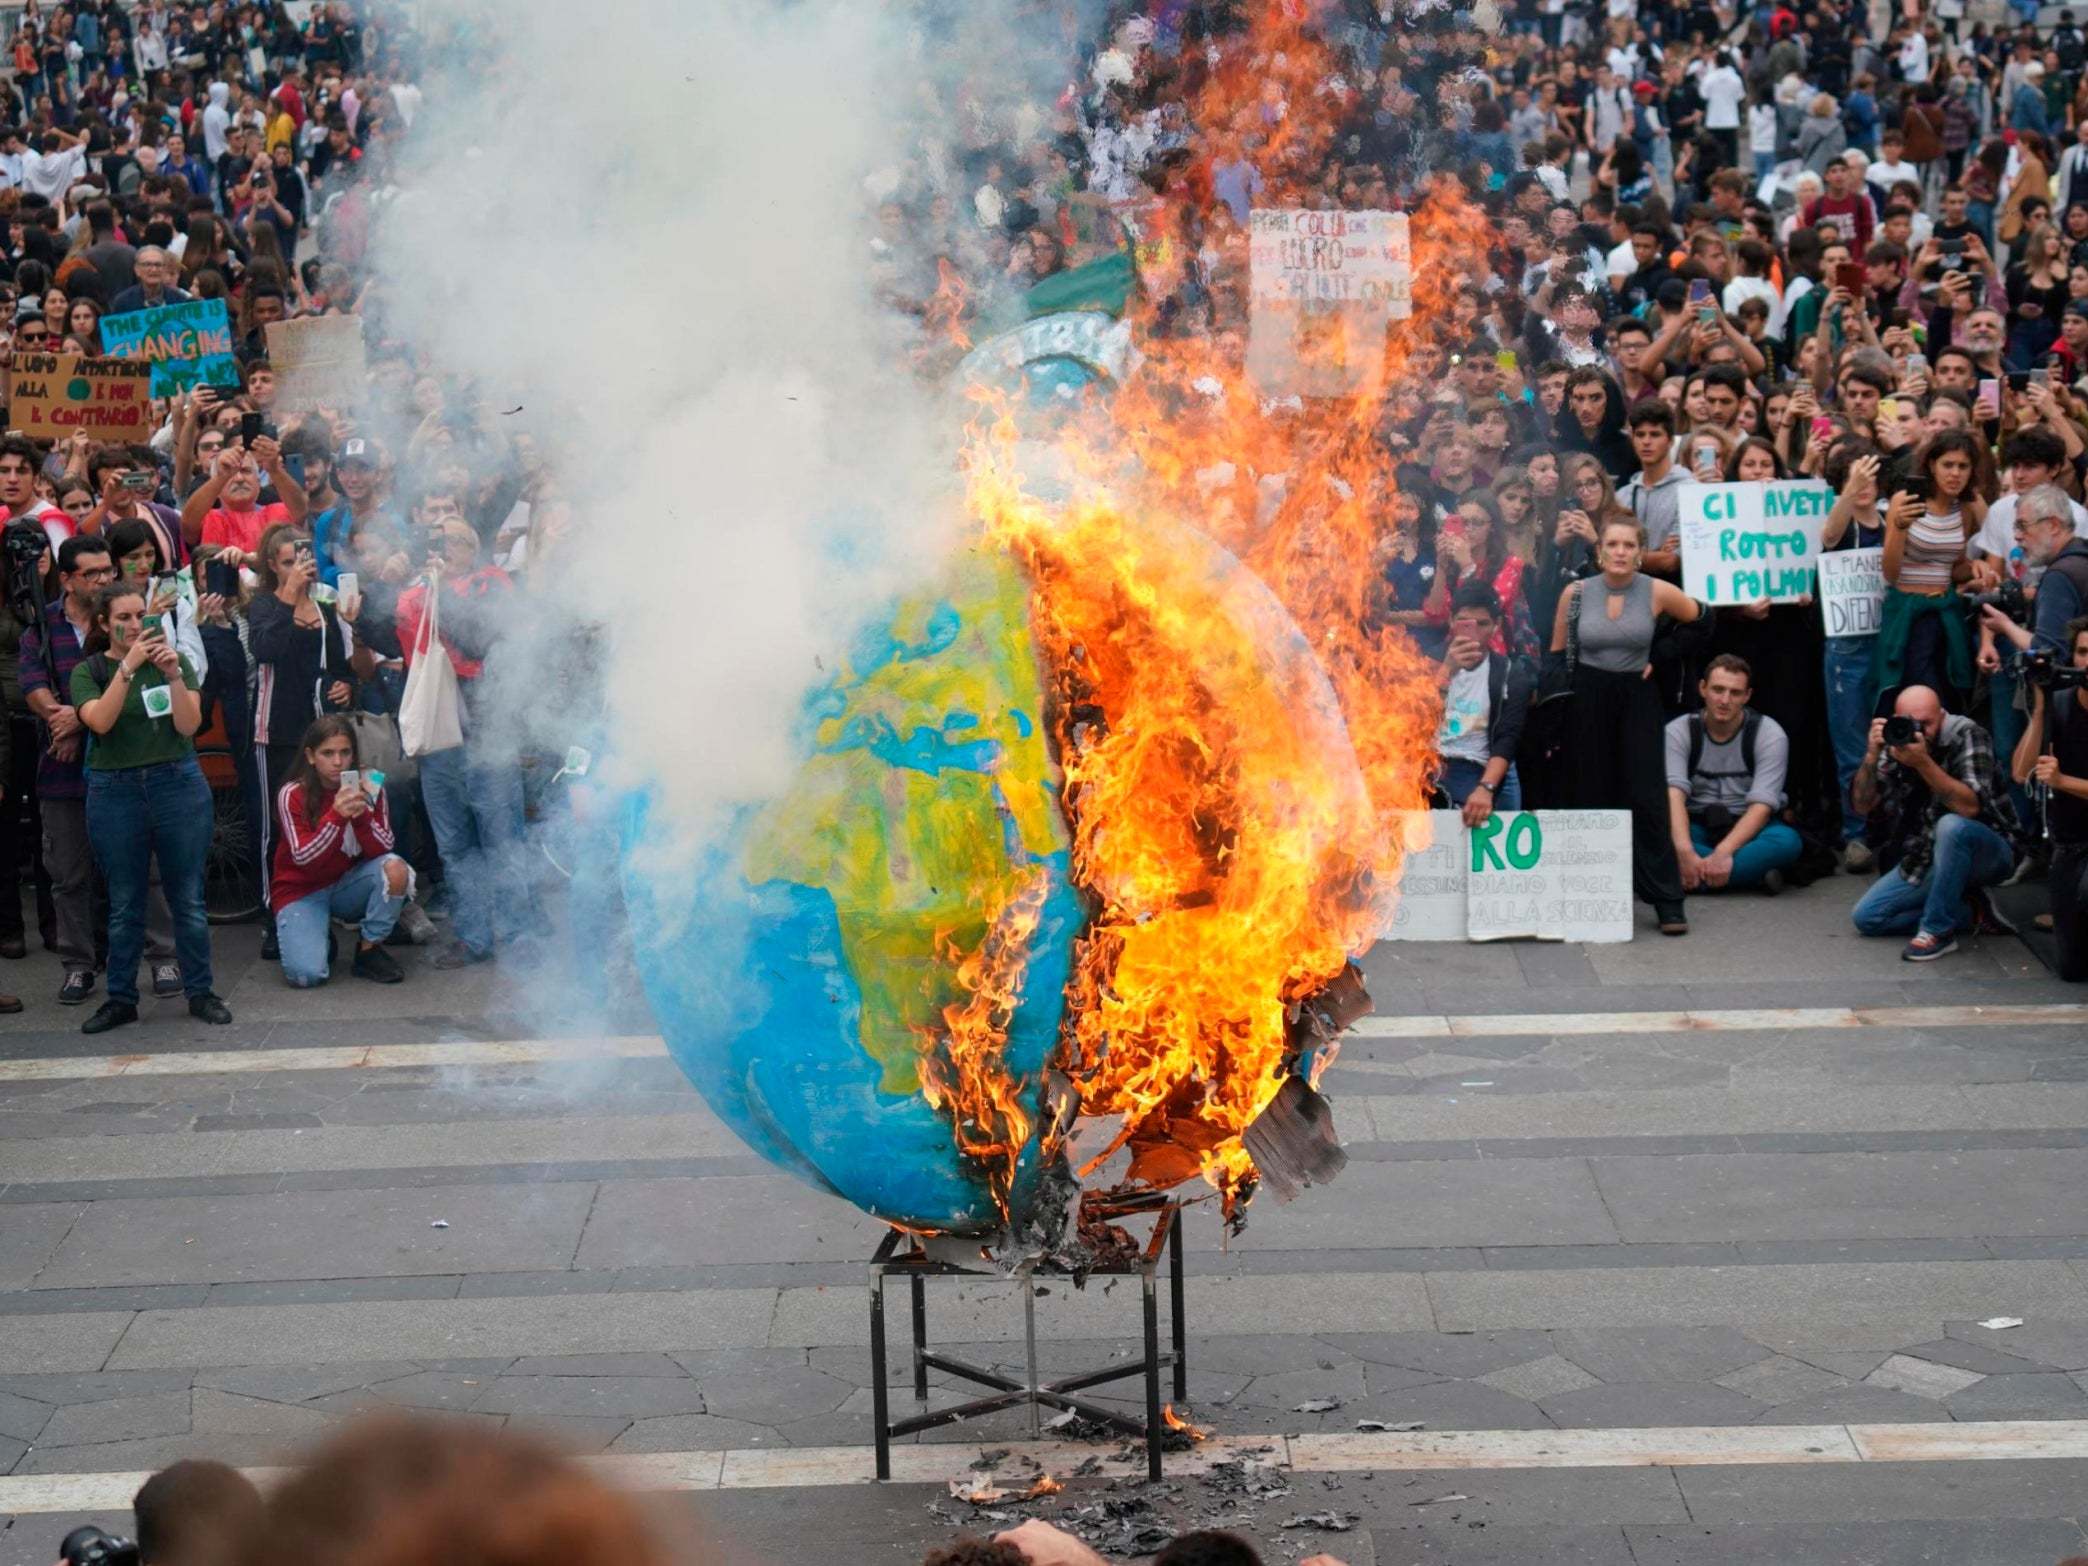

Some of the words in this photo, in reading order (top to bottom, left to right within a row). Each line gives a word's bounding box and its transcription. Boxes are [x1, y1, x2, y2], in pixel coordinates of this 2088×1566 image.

[105, 315, 141, 337] THE
[144, 304, 203, 326] CLIMATE
[207, 302, 222, 317] IS
[110, 325, 233, 361] CHANGING
[11, 353, 58, 374] L'UOMO
[15, 380, 49, 398] ALLA
[1703, 492, 1736, 520] CI
[1719, 528, 1807, 561] ROTTO
[1842, 555, 1883, 574] PIANE
[1706, 573, 1717, 601] I
[1471, 874, 1546, 895] DIAMO
[1558, 874, 1615, 894] VOCE
[1474, 899, 1540, 925] ALLA
[1546, 899, 1632, 924] SCIENZA
